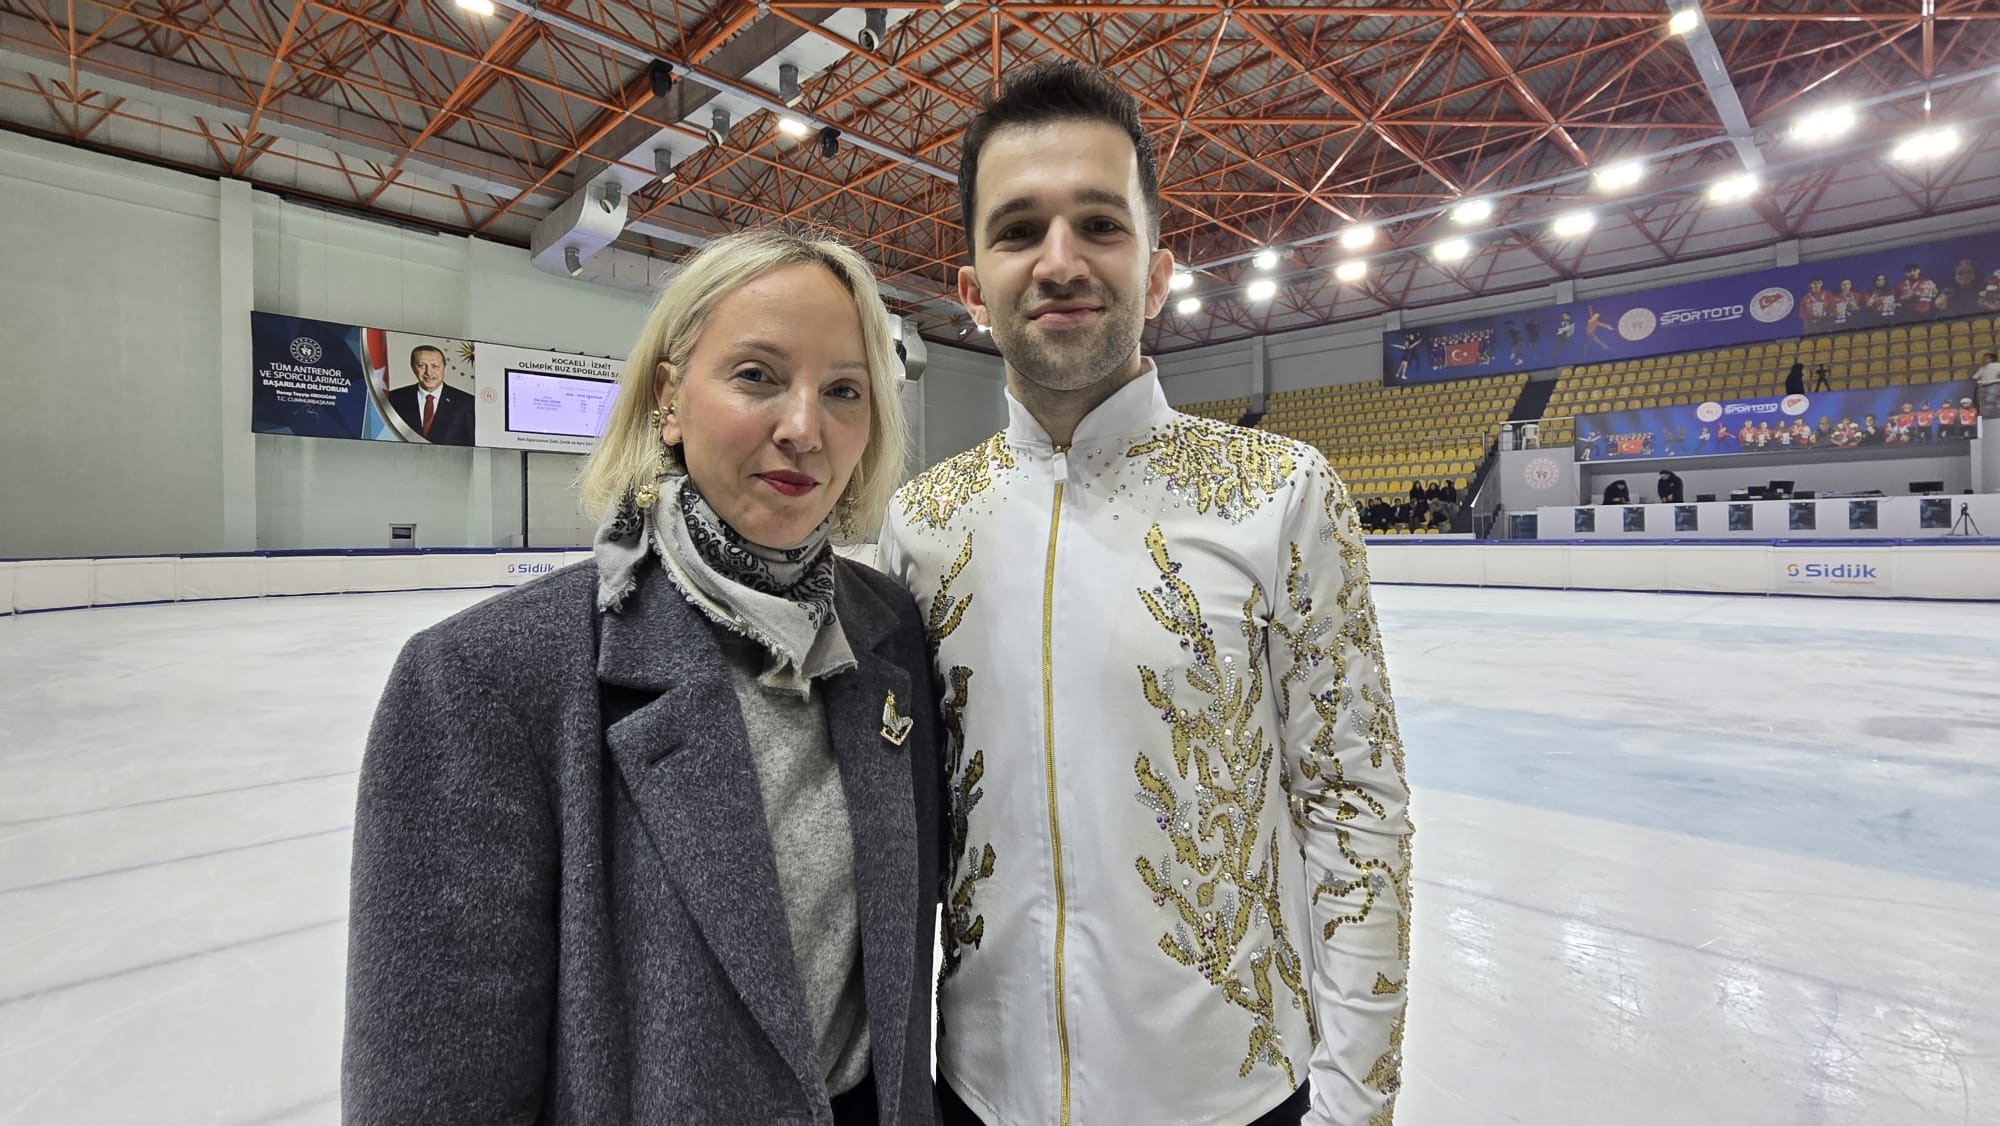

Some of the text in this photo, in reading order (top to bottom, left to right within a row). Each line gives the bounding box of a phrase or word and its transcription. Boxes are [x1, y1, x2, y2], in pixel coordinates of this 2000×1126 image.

[269, 361, 342, 377] TÜM ANTRENÖR
[518, 361, 553, 371] OLİMPİK
[554, 365, 571, 373] BUZ
[572, 367, 610, 377] SPORLARI
[551, 357, 586, 367] KOCAELİ
[591, 360, 612, 370] İZMİT
[259, 369, 351, 386] VE SPORCULARIMIZA
[263, 379, 349, 393] BAŞARILAR DİLİYORUM
[1805, 563, 1877, 578] Sidijk
